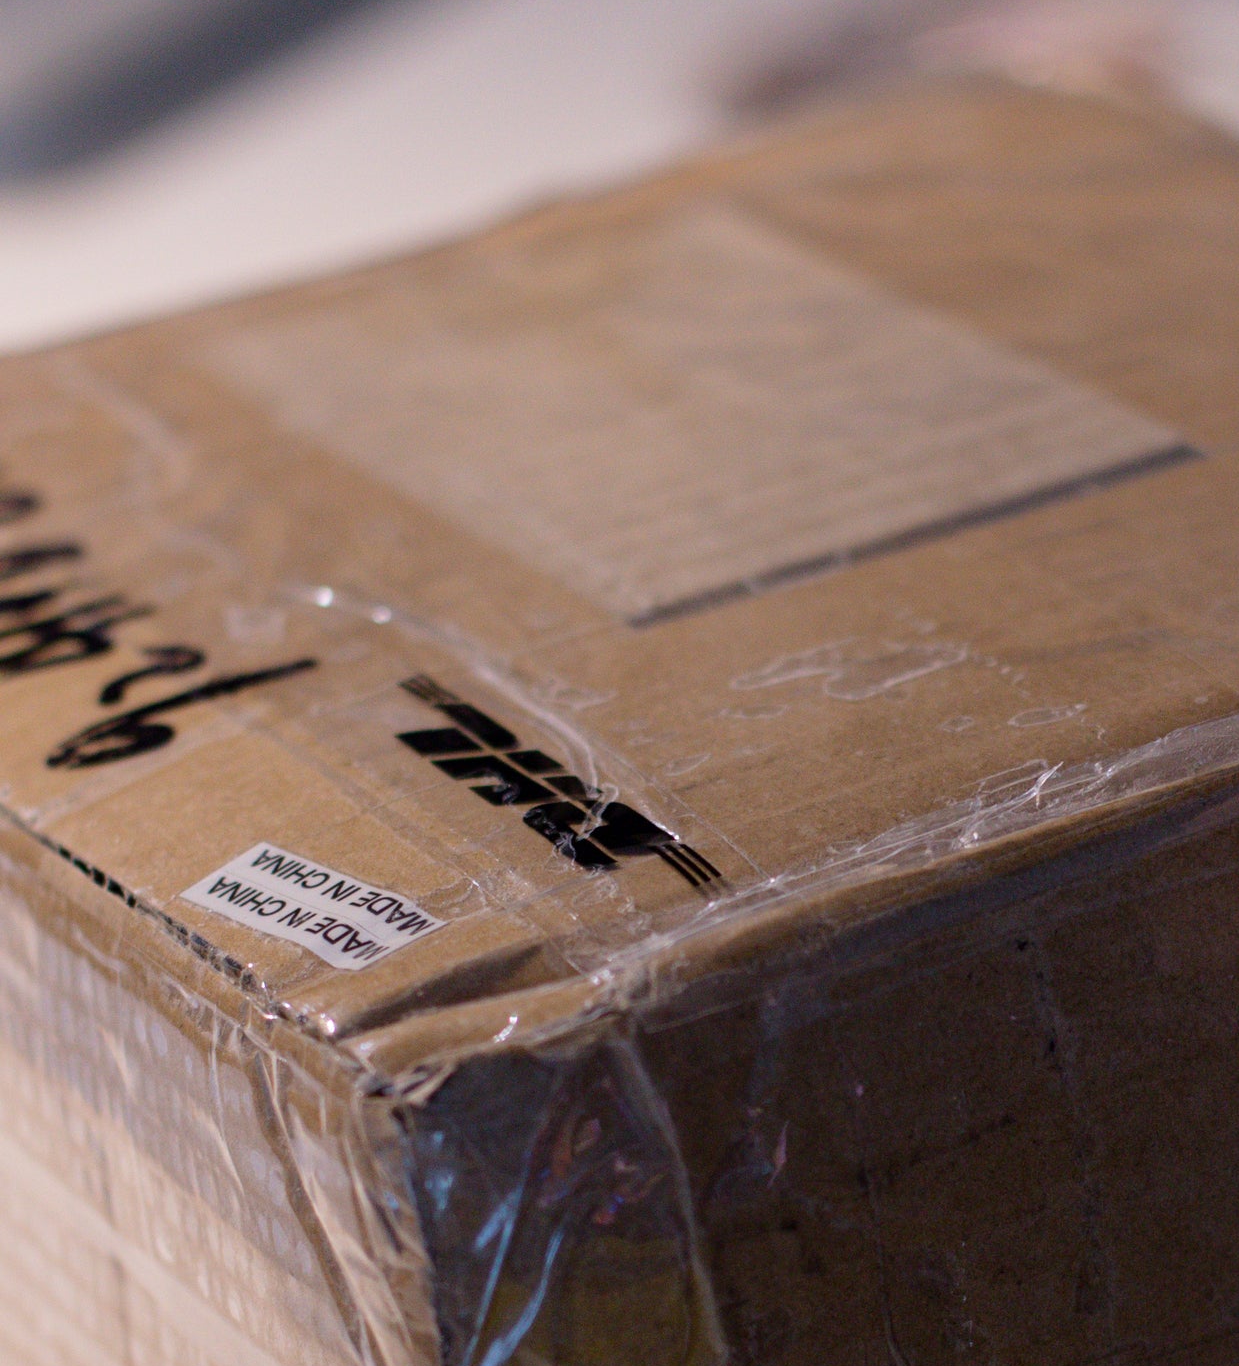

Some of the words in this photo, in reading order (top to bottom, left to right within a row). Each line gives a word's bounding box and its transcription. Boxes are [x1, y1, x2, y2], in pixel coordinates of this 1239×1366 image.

[251, 850, 330, 889] CHINA
[207, 877, 285, 916] CHINA
[321, 880, 361, 902] IN
[276, 908, 314, 928] IN
[351, 892, 434, 936] MADE
[307, 916, 388, 960] MADE
